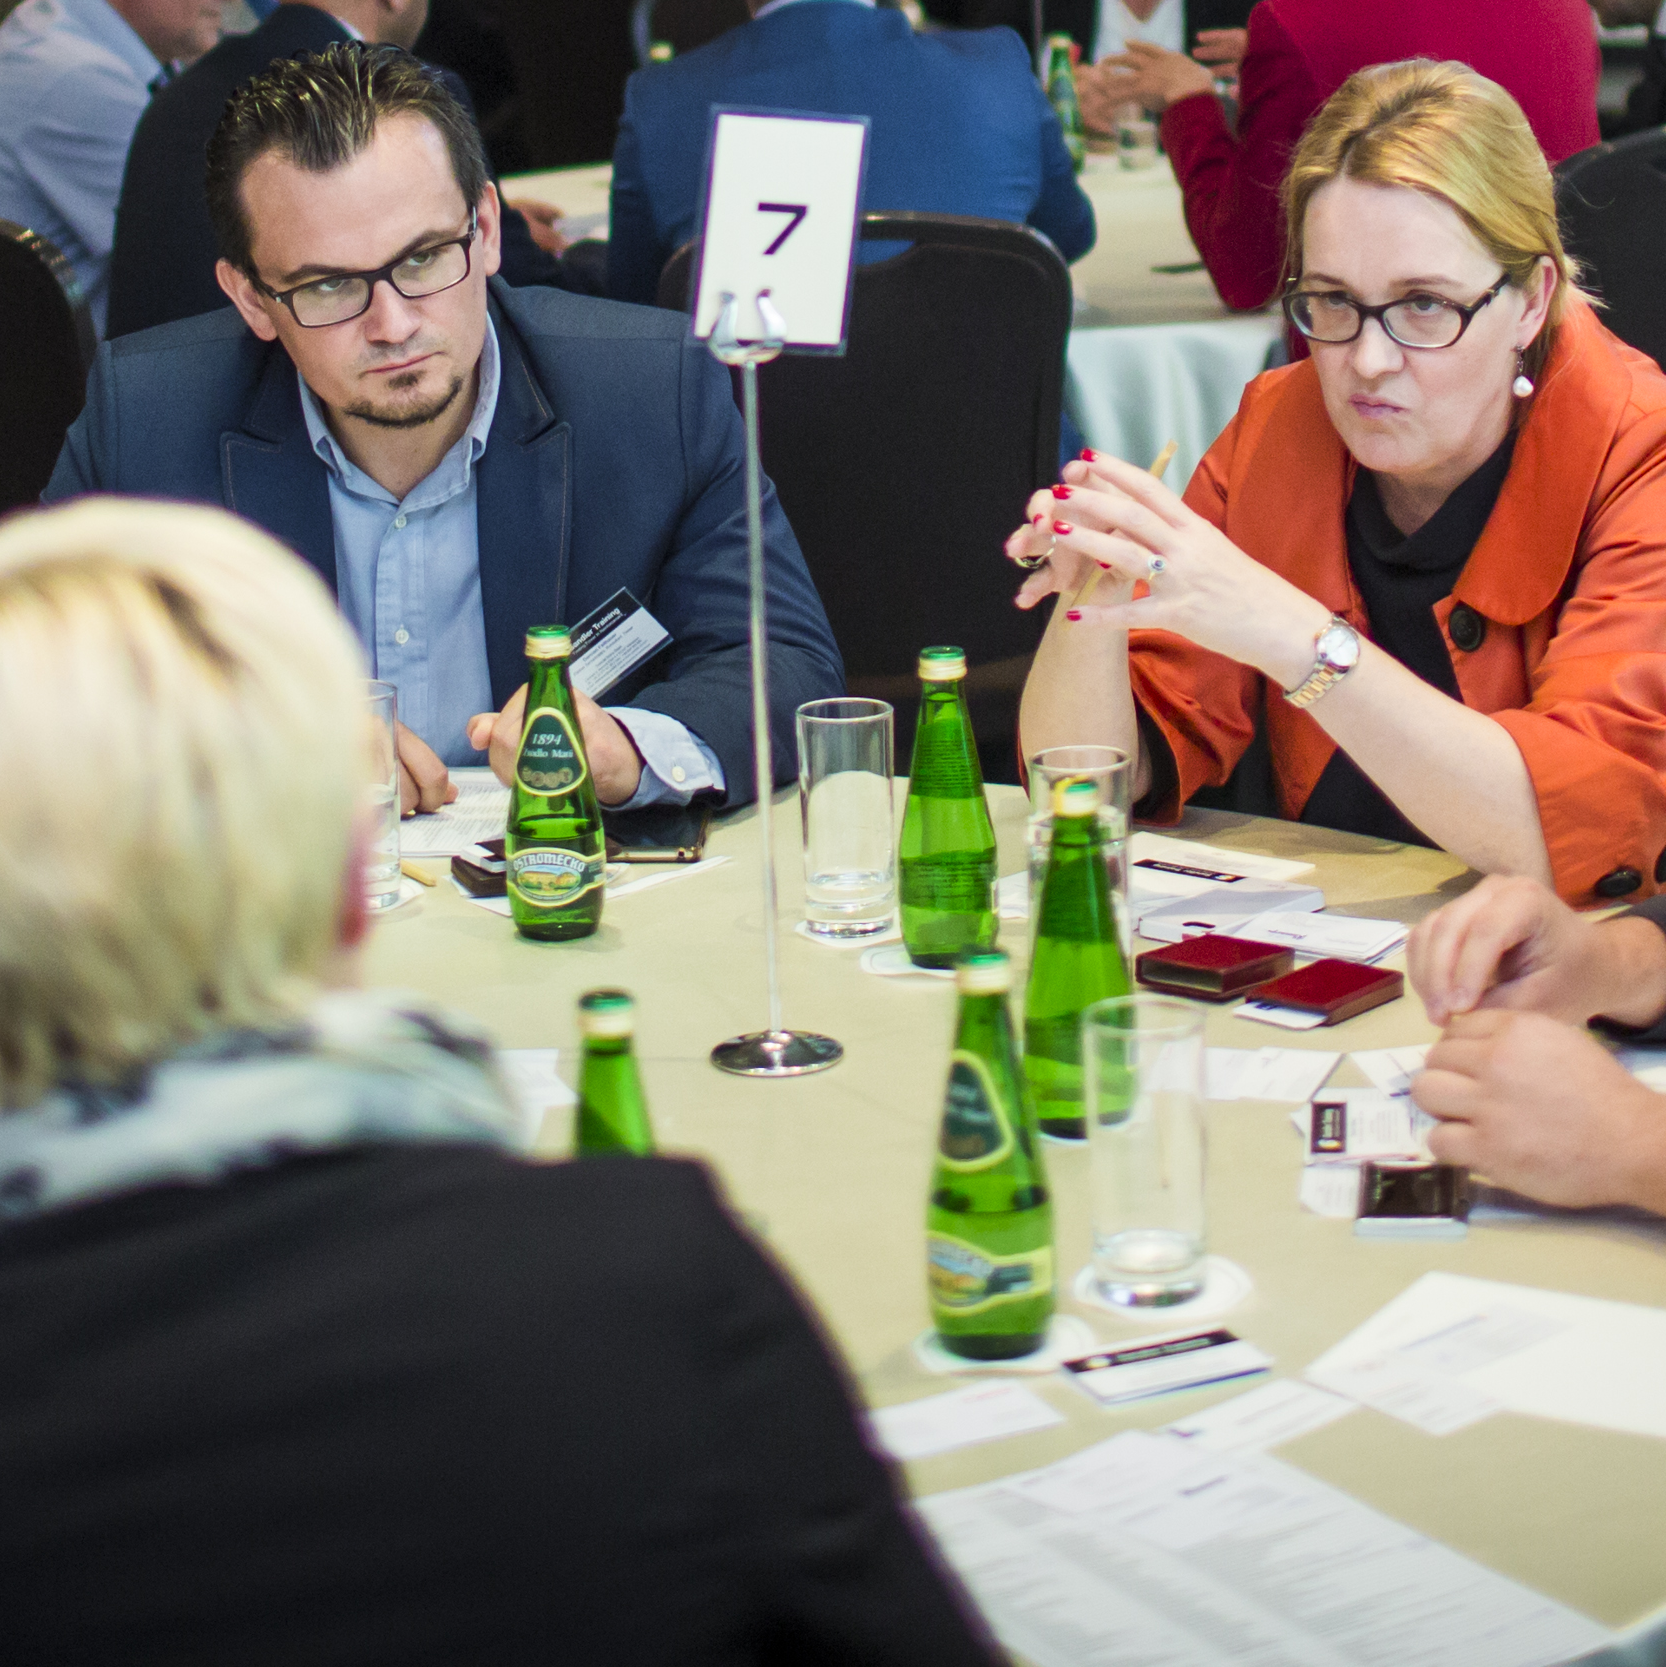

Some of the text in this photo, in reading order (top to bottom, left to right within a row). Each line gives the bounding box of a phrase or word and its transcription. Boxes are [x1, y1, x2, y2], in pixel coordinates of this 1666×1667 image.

[757, 202, 808, 256] 7
[572, 628, 594, 650] andler
[592, 607, 621, 631] Training
[532, 733, 562, 746] 1894
[513, 853, 585, 873] OSTROMECKO
